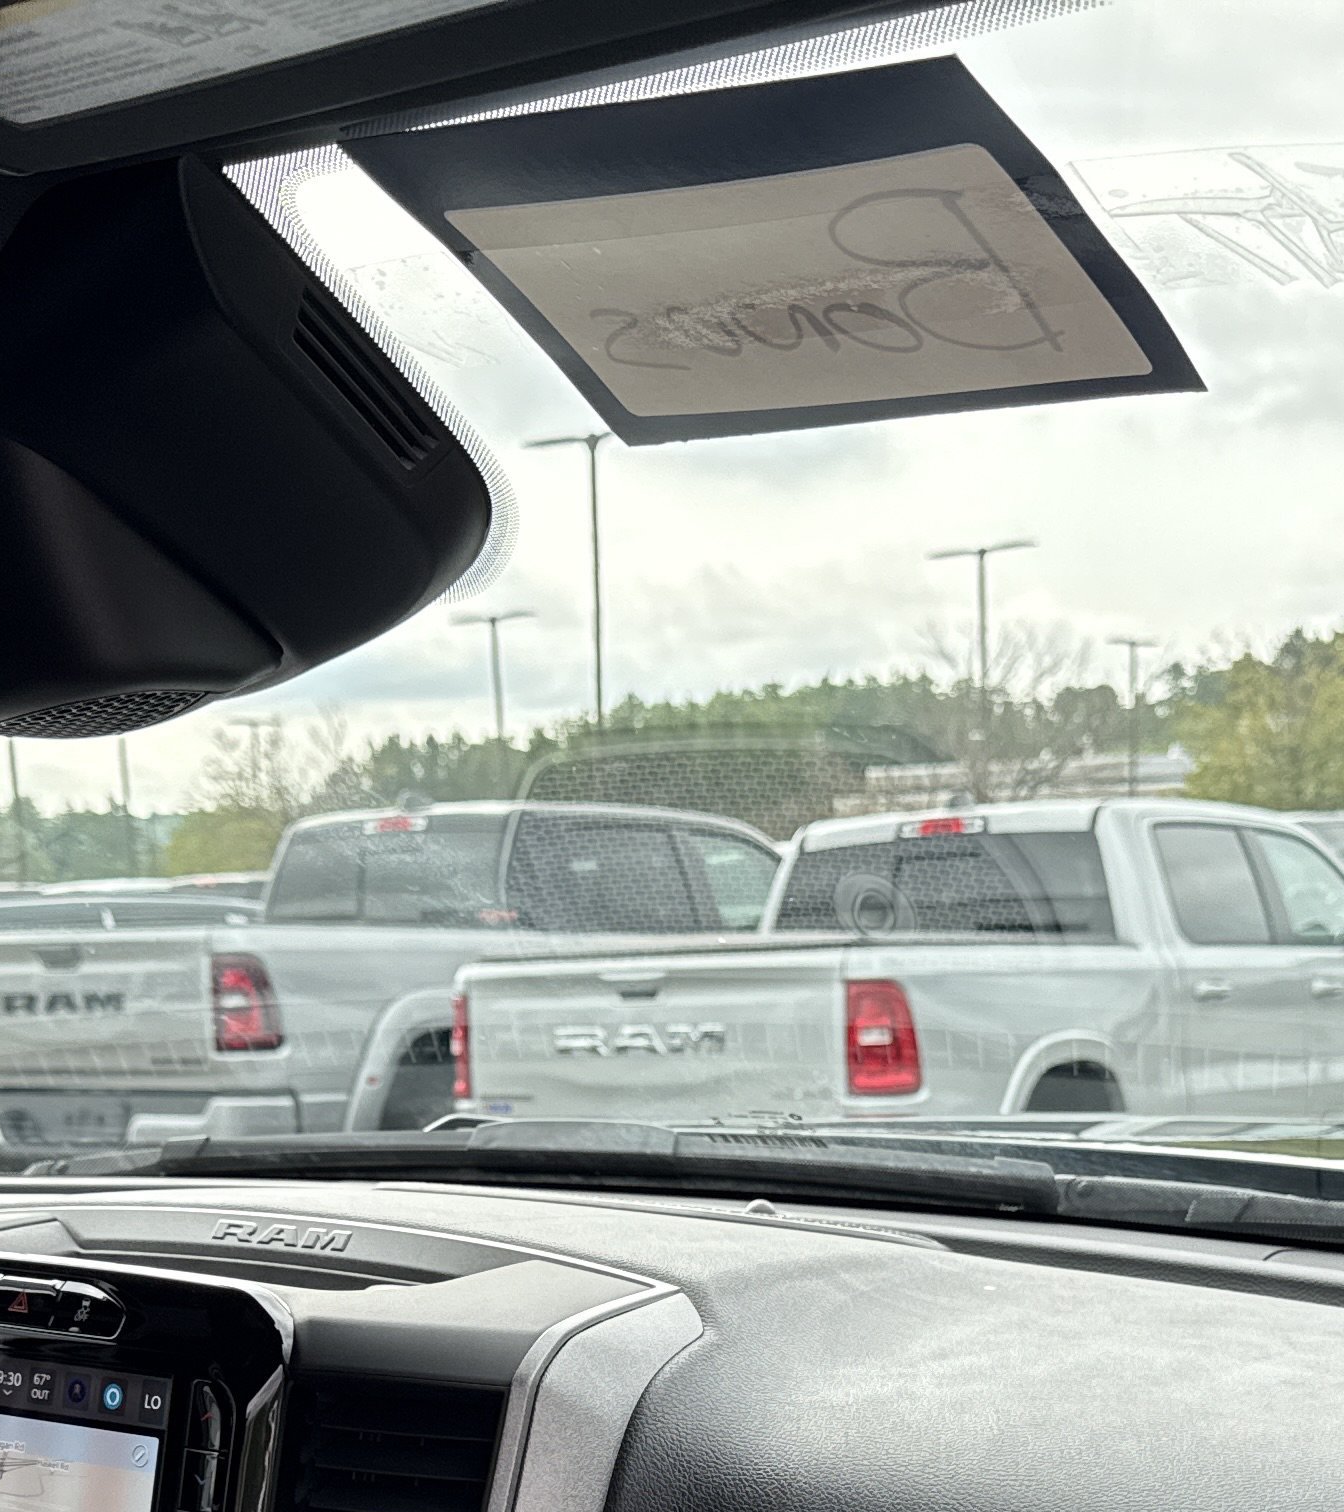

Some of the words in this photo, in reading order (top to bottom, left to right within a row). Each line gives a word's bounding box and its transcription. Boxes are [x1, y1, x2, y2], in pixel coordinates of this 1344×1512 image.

[1, 990, 126, 1017] RAM
[552, 1021, 726, 1057] RAM
[211, 1208, 353, 1252] RAM
[31, 1388, 51, 1401] OUT
[144, 1393, 163, 1411] LO
